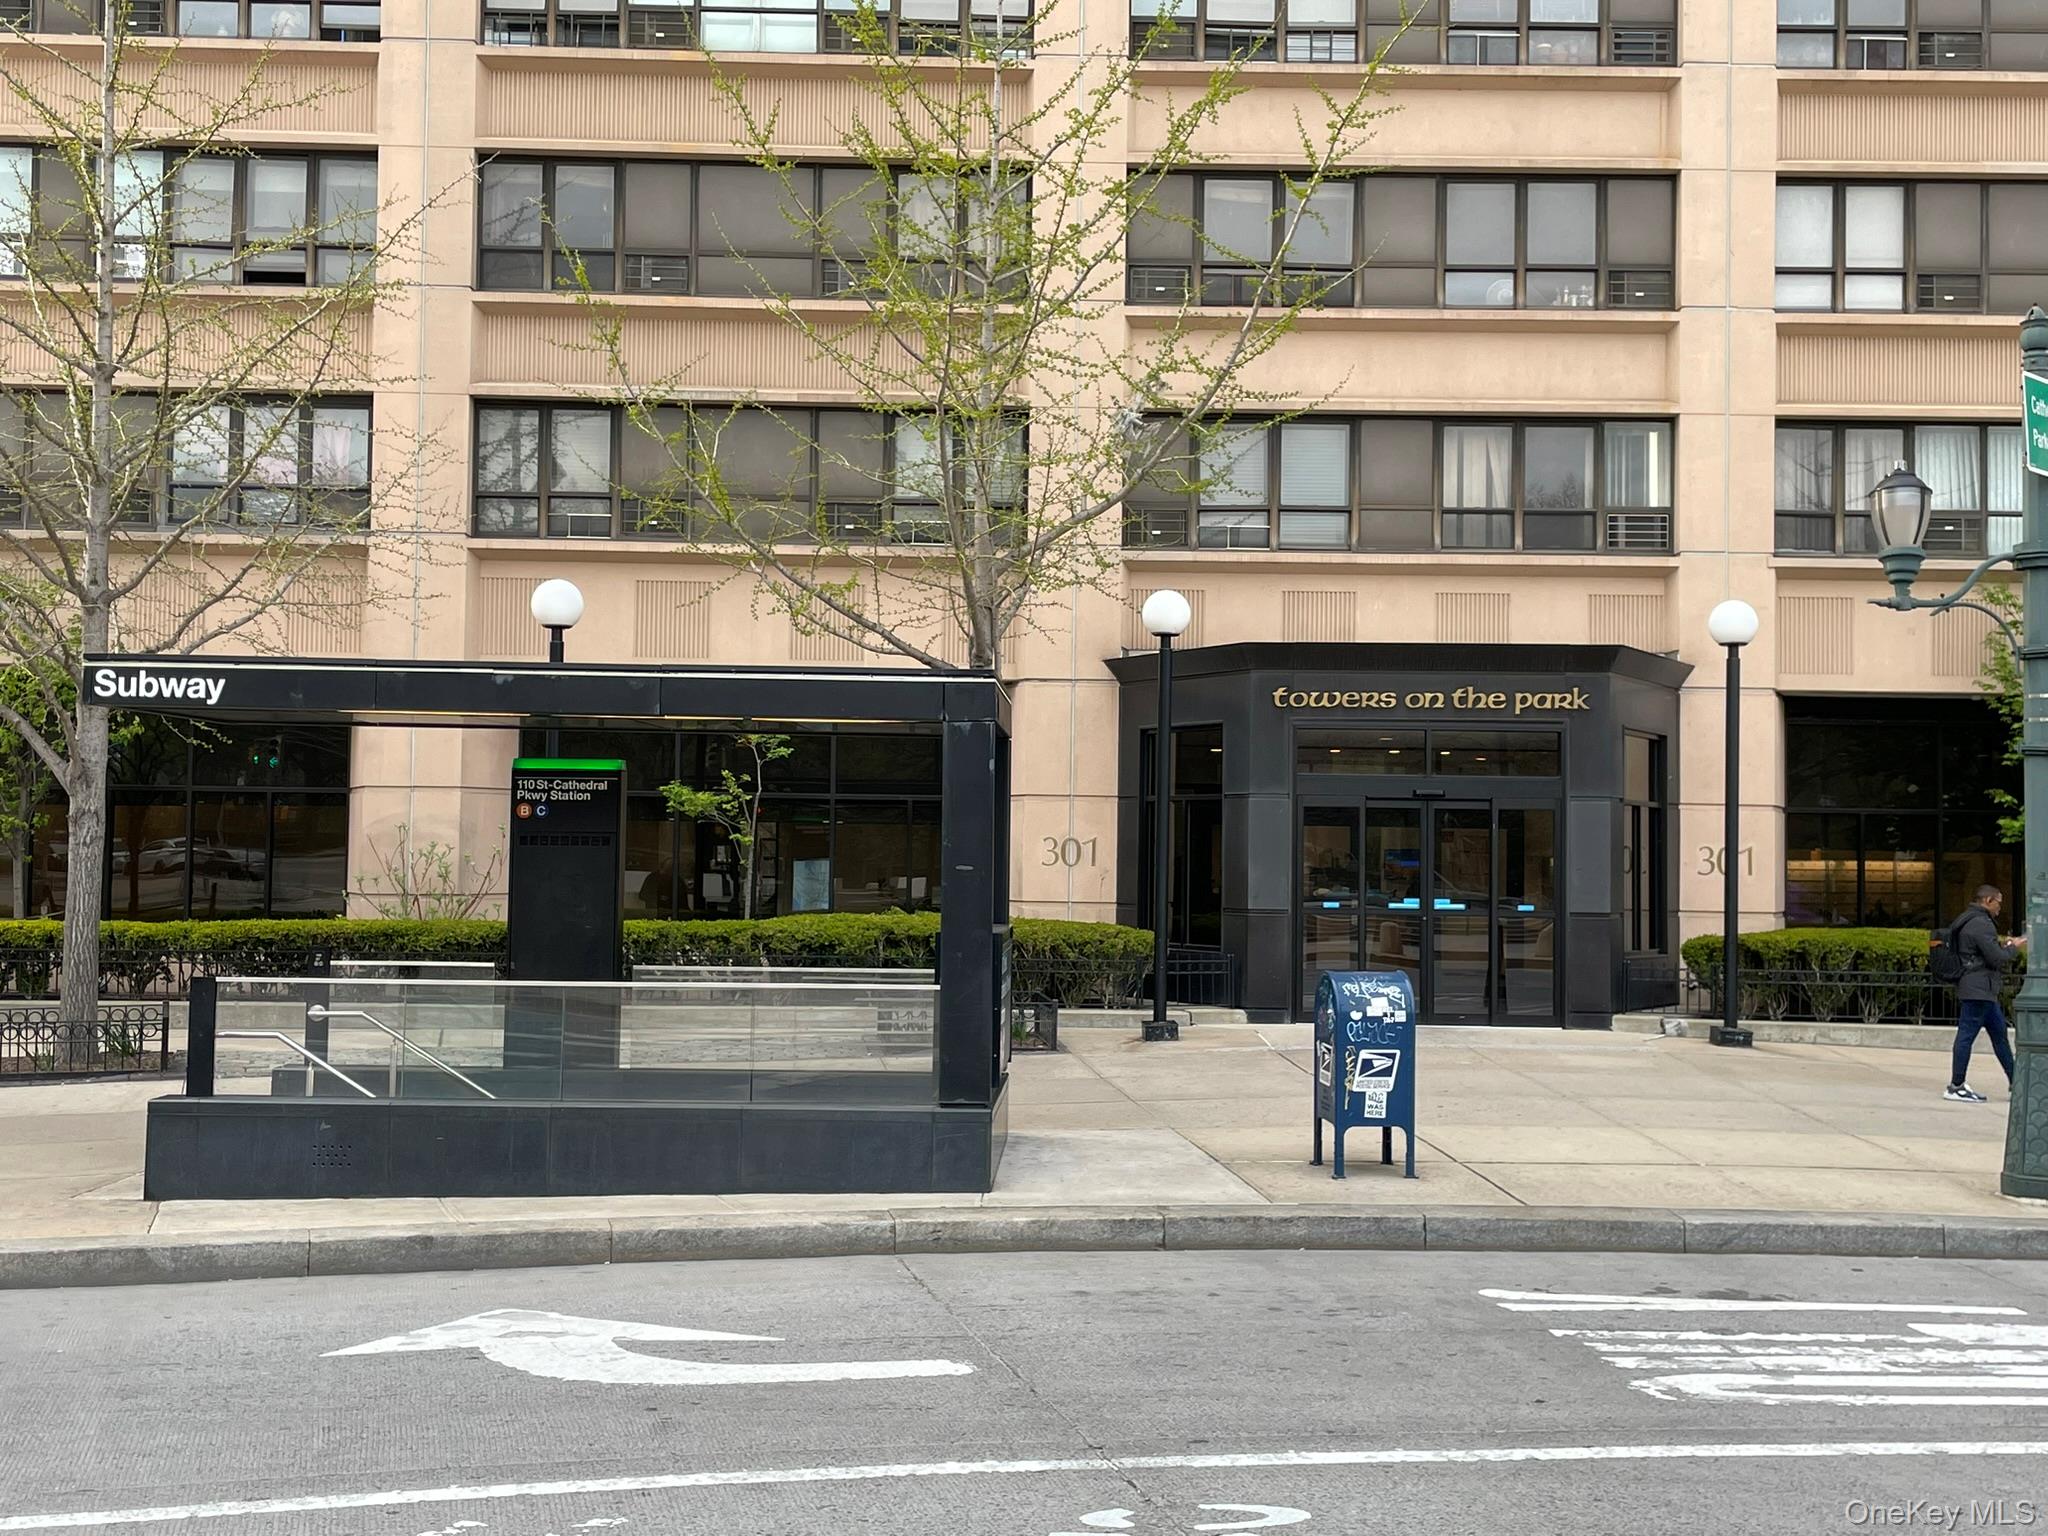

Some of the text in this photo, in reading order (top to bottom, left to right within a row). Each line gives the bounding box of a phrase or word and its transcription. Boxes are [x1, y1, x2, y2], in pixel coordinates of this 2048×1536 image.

[94, 669, 226, 705] Subway
[1272, 686, 1591, 714] towers on the park
[517, 780, 607, 790] 110 St-Cathedral
[517, 791, 591, 802] Pkwy Station
[520, 806, 546, 816] B C
[1042, 836, 1097, 867] 301
